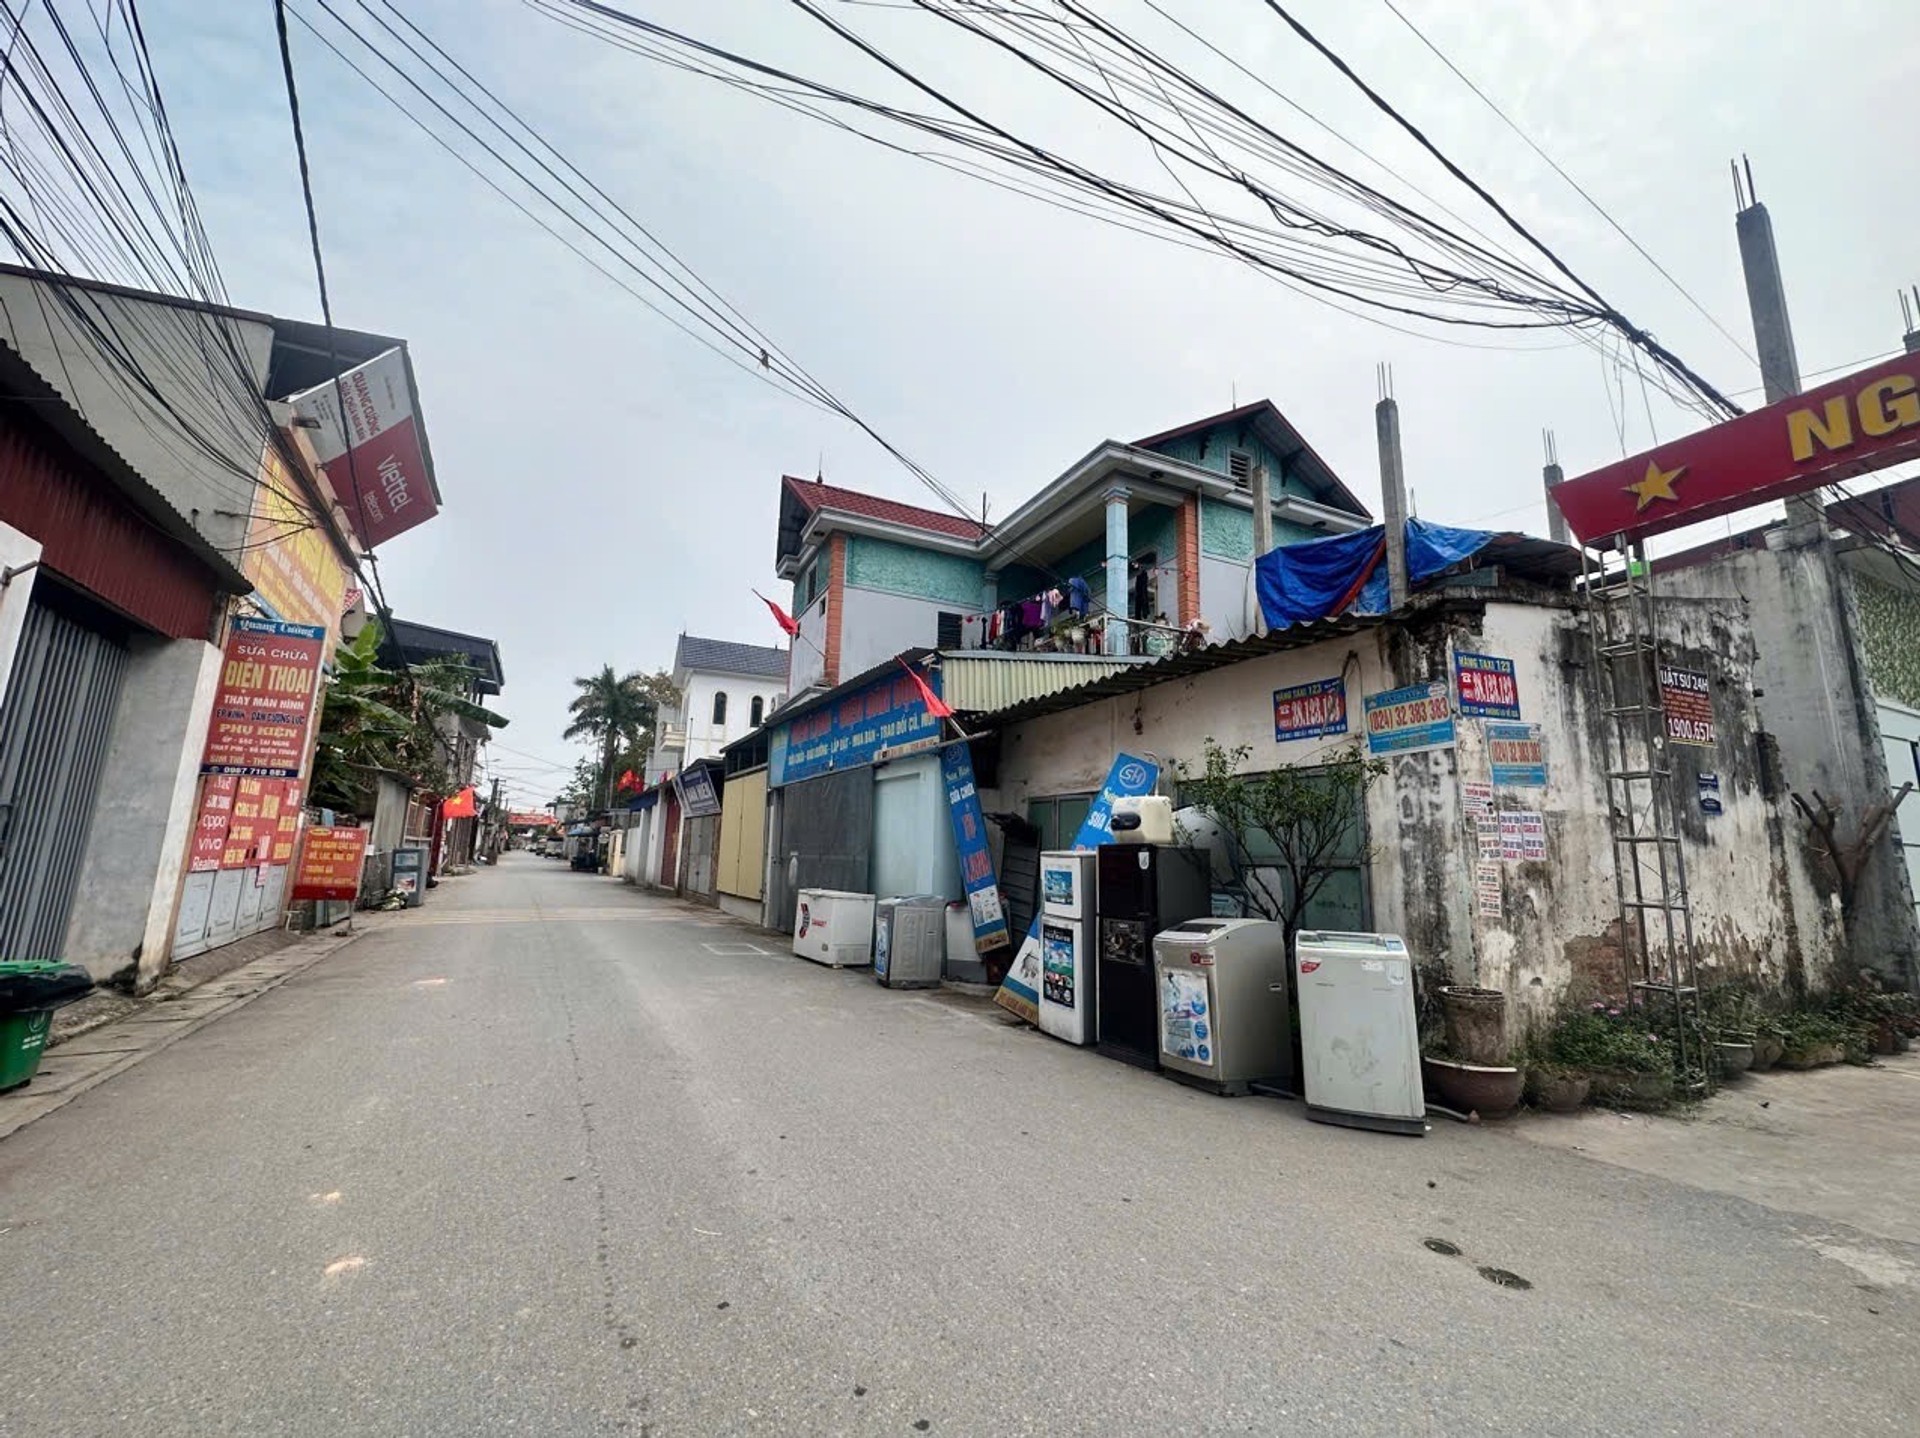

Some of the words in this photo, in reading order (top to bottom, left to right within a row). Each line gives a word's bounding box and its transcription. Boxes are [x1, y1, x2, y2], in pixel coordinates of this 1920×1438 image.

[377, 453, 410, 513] viettel
[1496, 660, 1511, 672] 123
[224, 658, 266, 694] ĐIỆN
[268, 665, 314, 699] THOẠI
[1308, 684, 1322, 696] 123
[224, 694, 250, 706] THAY
[1394, 705, 1408, 726] 32
[1409, 701, 1428, 724] 383
[1429, 697, 1449, 720] 383
[198, 834, 222, 850] vivo
[191, 856, 219, 870] Realme
